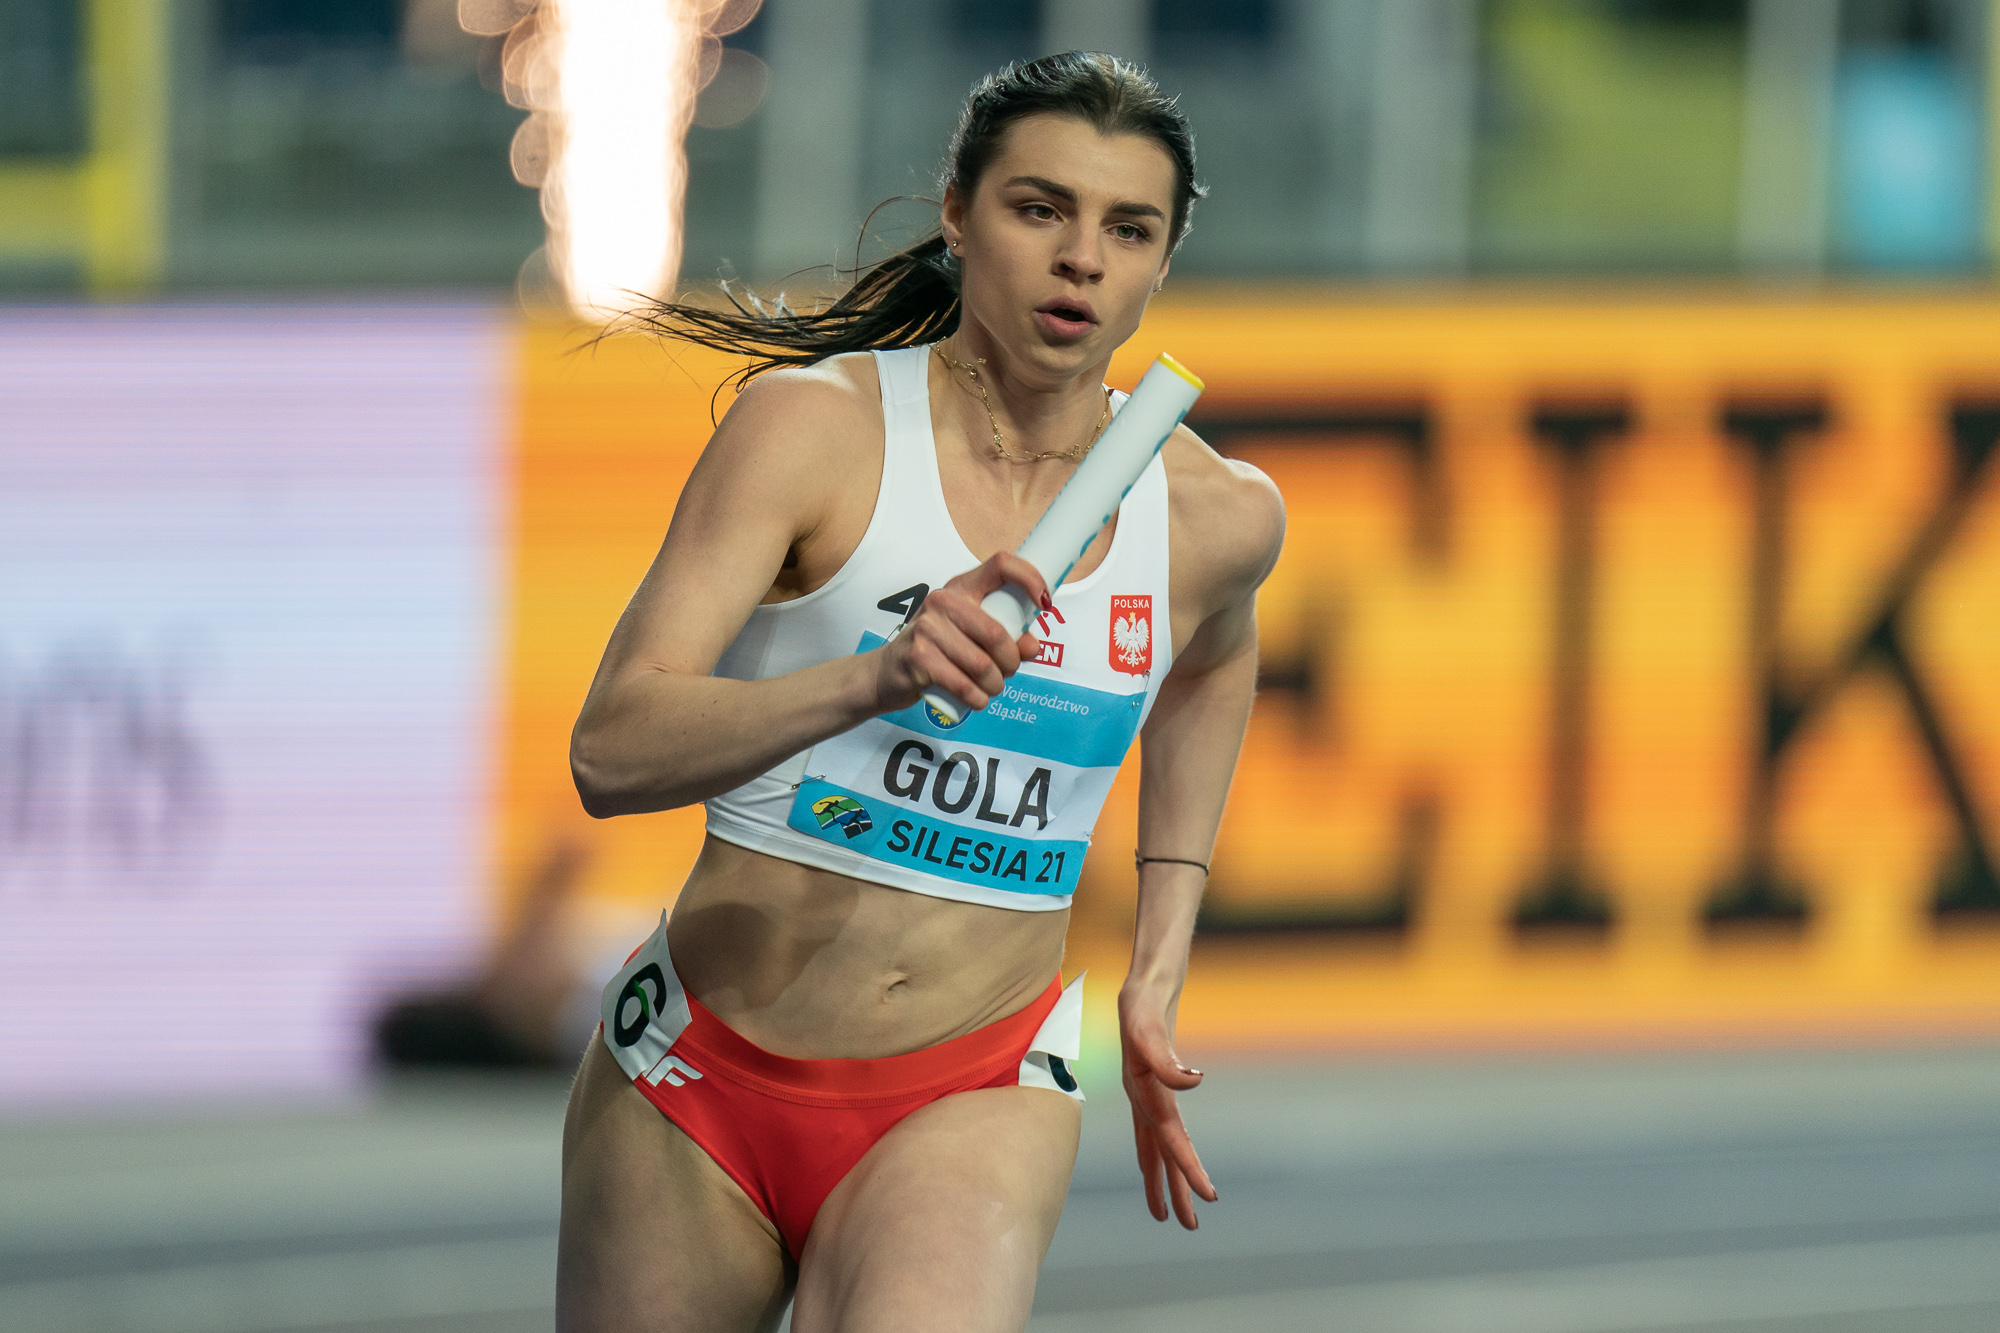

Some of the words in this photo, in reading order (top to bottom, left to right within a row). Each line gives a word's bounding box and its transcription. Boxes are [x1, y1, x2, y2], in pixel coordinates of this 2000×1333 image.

[1113, 598, 1150, 609] POLSKA
[987, 700, 1037, 724] Śląskie
[883, 739, 1053, 831] GOLA
[886, 819, 1028, 882] SILESIA
[1034, 850, 1066, 883] 21
[614, 962, 667, 1048] 6
